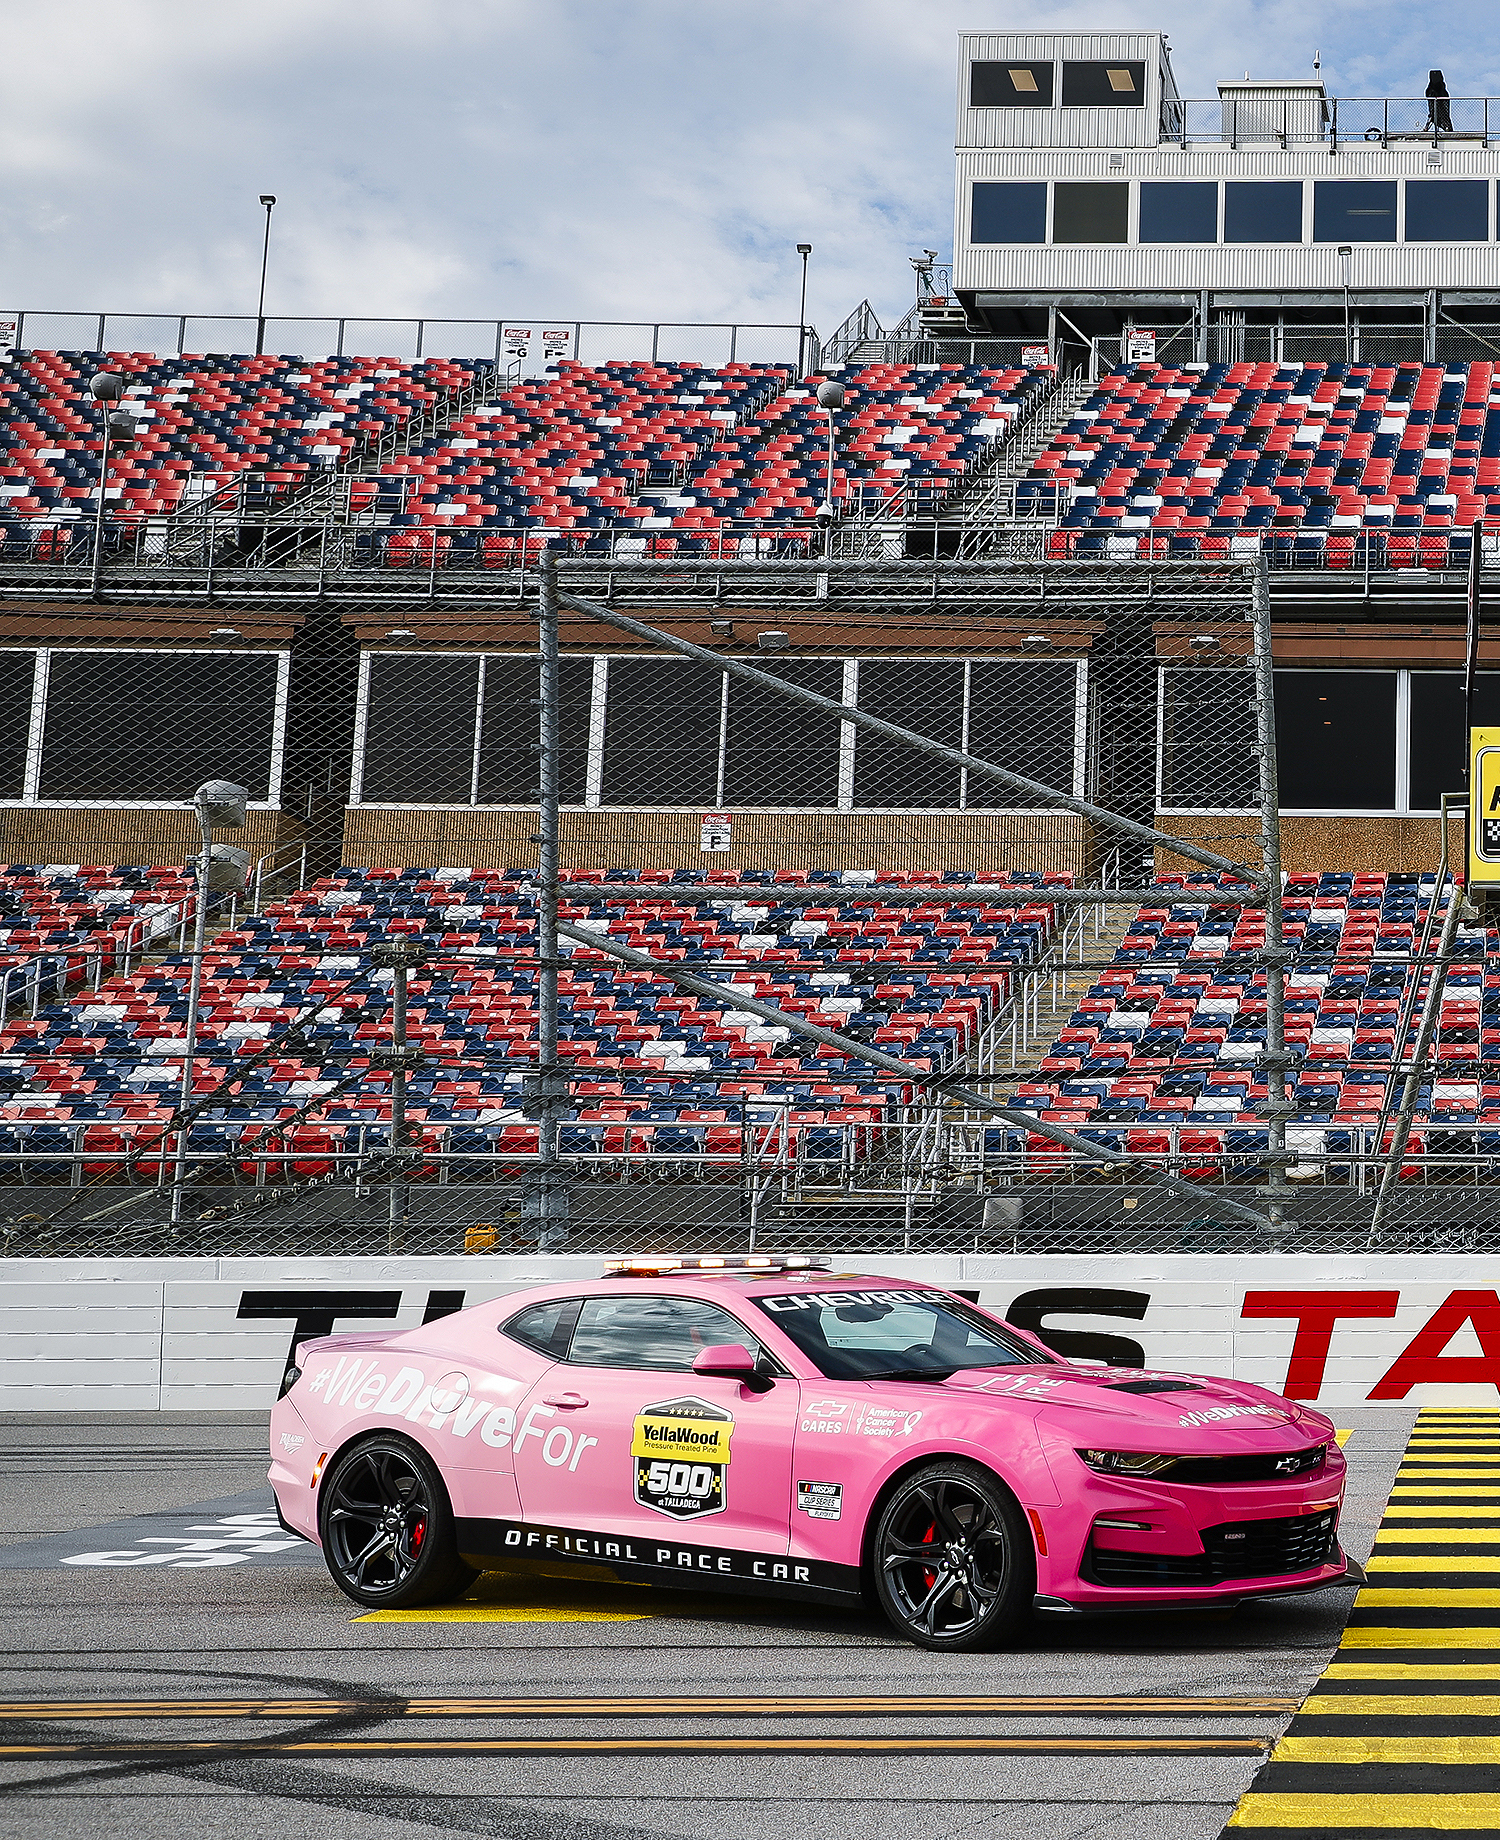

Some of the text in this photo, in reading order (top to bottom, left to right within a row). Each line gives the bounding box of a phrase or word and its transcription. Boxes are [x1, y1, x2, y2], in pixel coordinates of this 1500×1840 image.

[516, 347, 528, 358] G
[544, 349, 554, 359] F
[1131, 349, 1141, 359] E
[710, 835, 722, 849] F
[308, 1356, 599, 1472] #WeDriveFor
[868, 1407, 909, 1418] American
[801, 1419, 844, 1434] CARES
[865, 1417, 897, 1427] Cancer
[863, 1426, 895, 1438] Society
[644, 1440, 718, 1453] Pressure Treated Pine
[647, 1461, 714, 1499] 500
[812, 1484, 837, 1495] NASCAR
[664, 1497, 701, 1509] TALLADEGA
[804, 1496, 836, 1507] CUP SERIES
[504, 1529, 810, 1582] OFFICIAL PACE CAR
